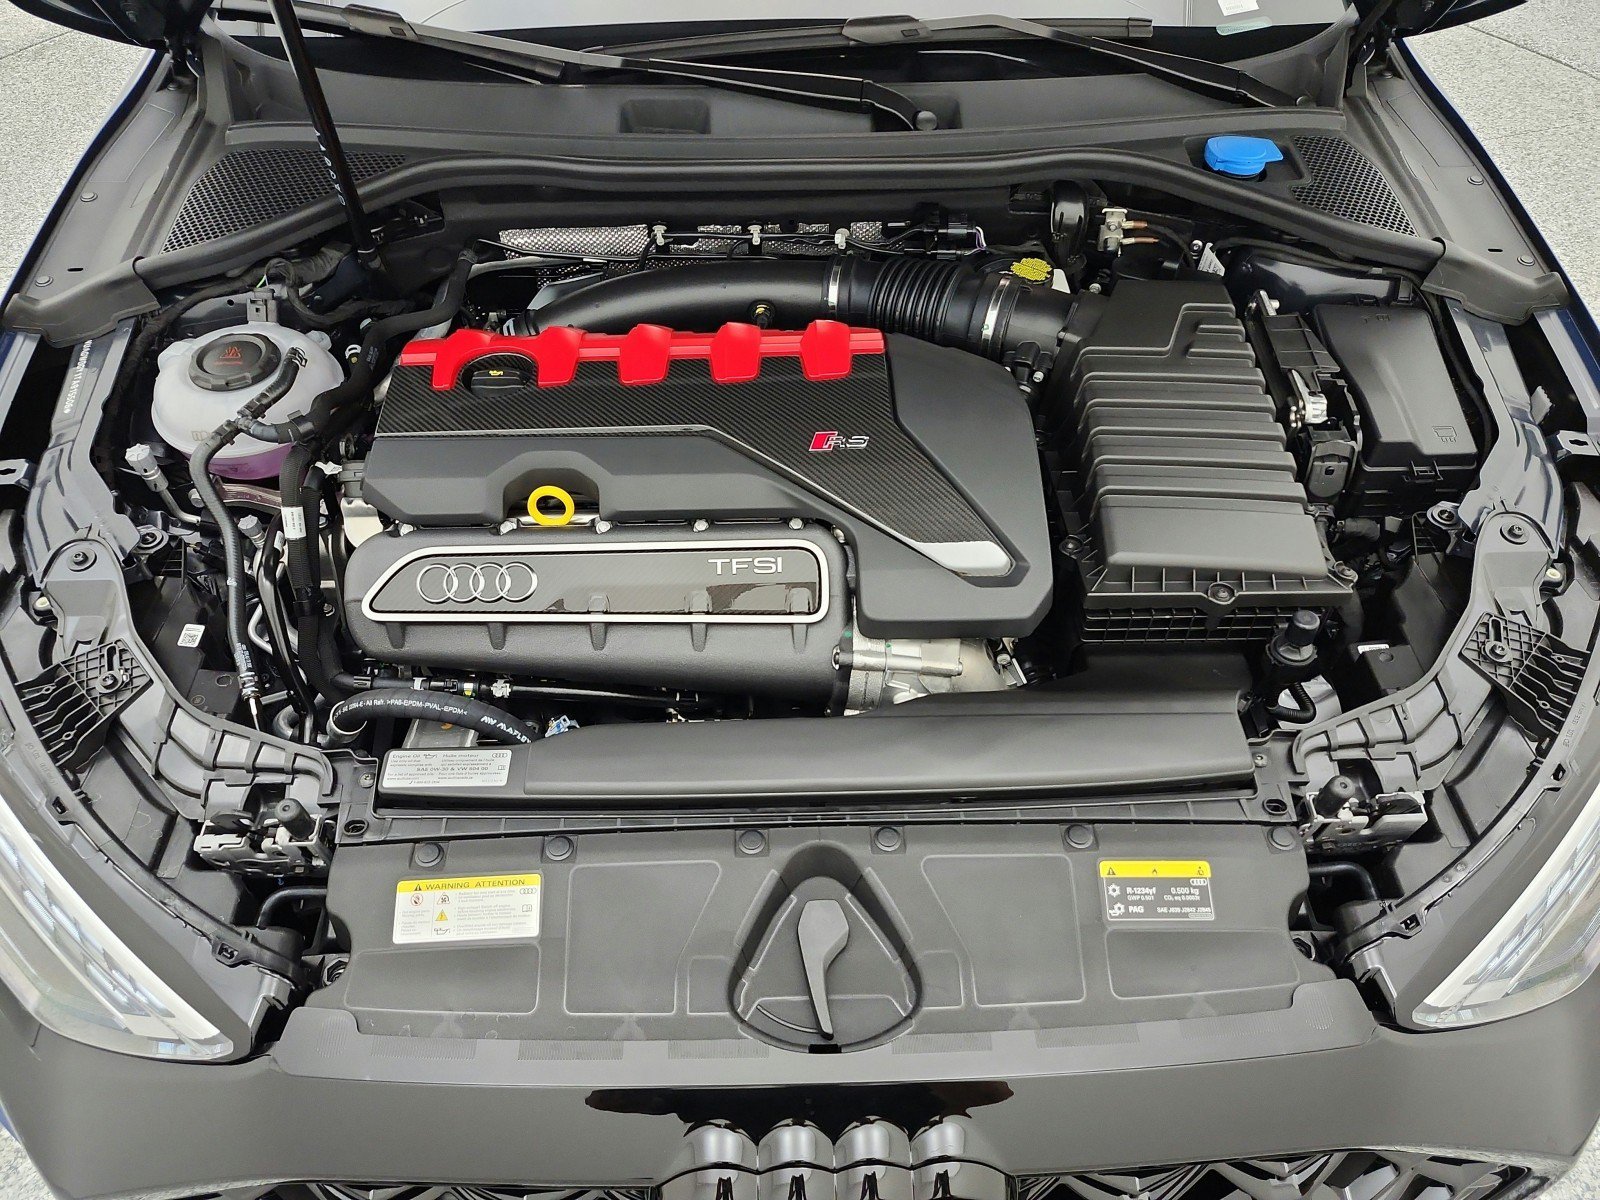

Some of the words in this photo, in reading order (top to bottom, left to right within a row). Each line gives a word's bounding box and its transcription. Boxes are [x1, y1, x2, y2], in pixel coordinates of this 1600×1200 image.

[815, 433, 869, 451] RS
[707, 556, 784, 575] TFSI
[425, 881, 470, 890] WARNING
[475, 879, 525, 887] ATTENTION
[1126, 887, 1156, 895] R-1234yf
[1190, 887, 1200, 896] kg
